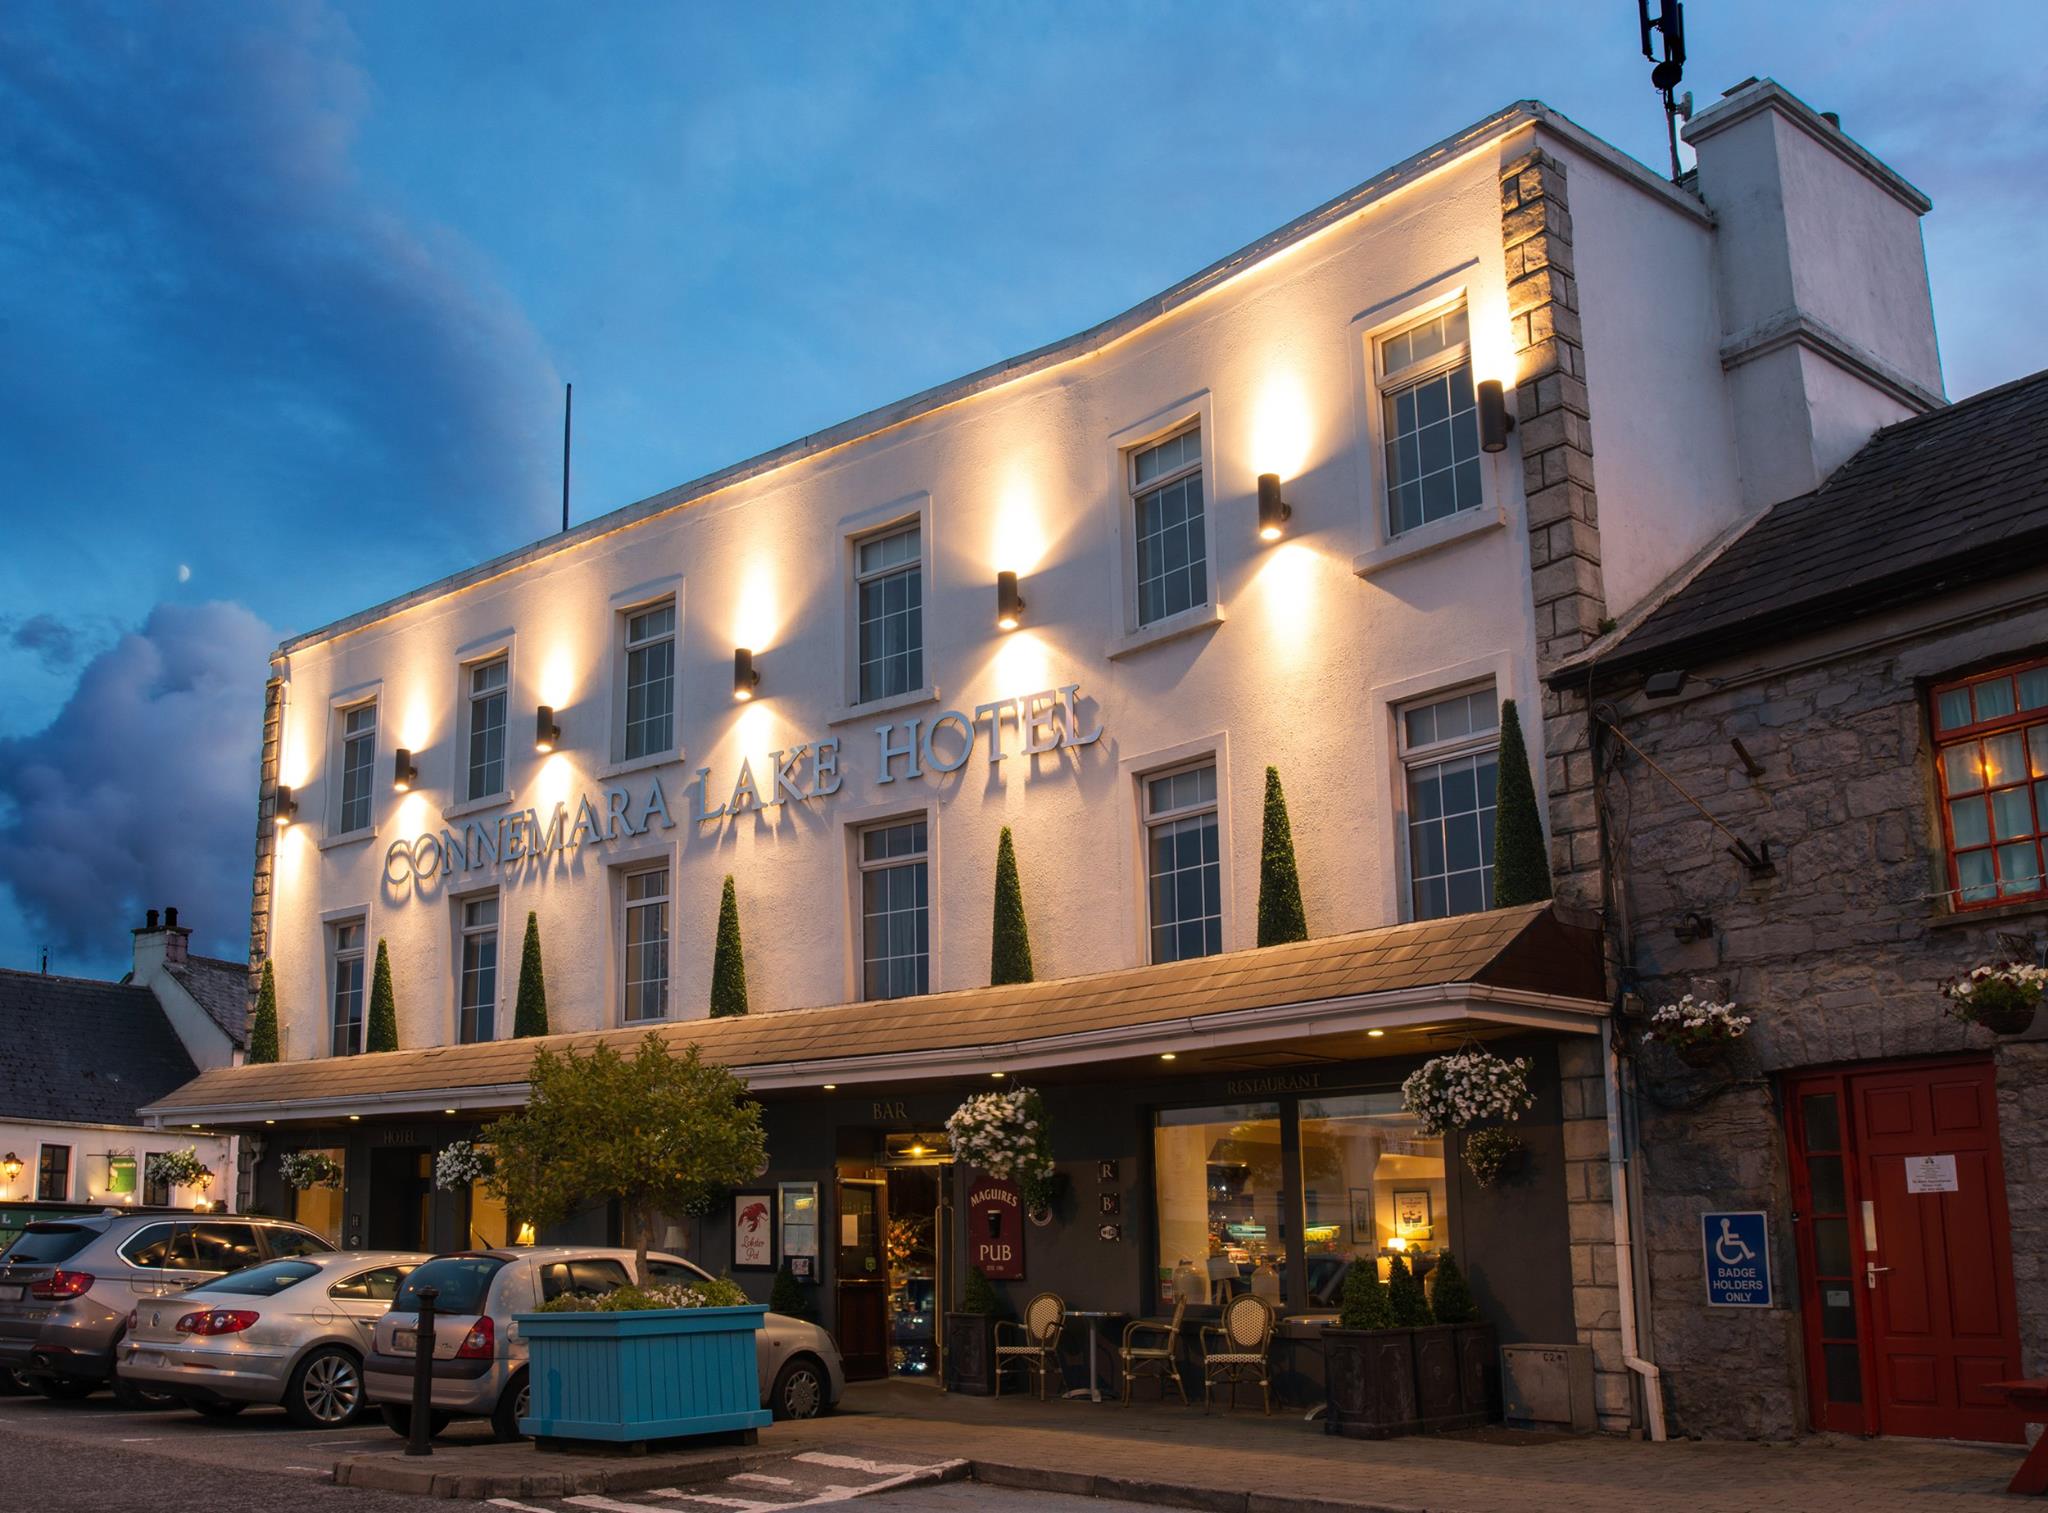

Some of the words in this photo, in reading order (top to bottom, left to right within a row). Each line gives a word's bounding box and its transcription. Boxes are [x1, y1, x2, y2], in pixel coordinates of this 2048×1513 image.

[385, 776, 676, 885] CONNEMARA
[696, 737, 843, 821] LAKE
[874, 683, 1105, 785] HOTEL
[1228, 1072, 1320, 1095] RESTAURANT
[873, 1102, 908, 1120] BAR
[383, 1129, 416, 1145] HOTEL
[1102, 1164, 1113, 1178] R
[970, 1188, 1018, 1207] MAGUIRES
[1103, 1197, 1112, 1211] B
[979, 1244, 1012, 1261] PUB
[1718, 1268, 1756, 1278] BADGE
[1713, 1280, 1763, 1290] HOLDERS
[1725, 1292, 1752, 1302] ONLY
